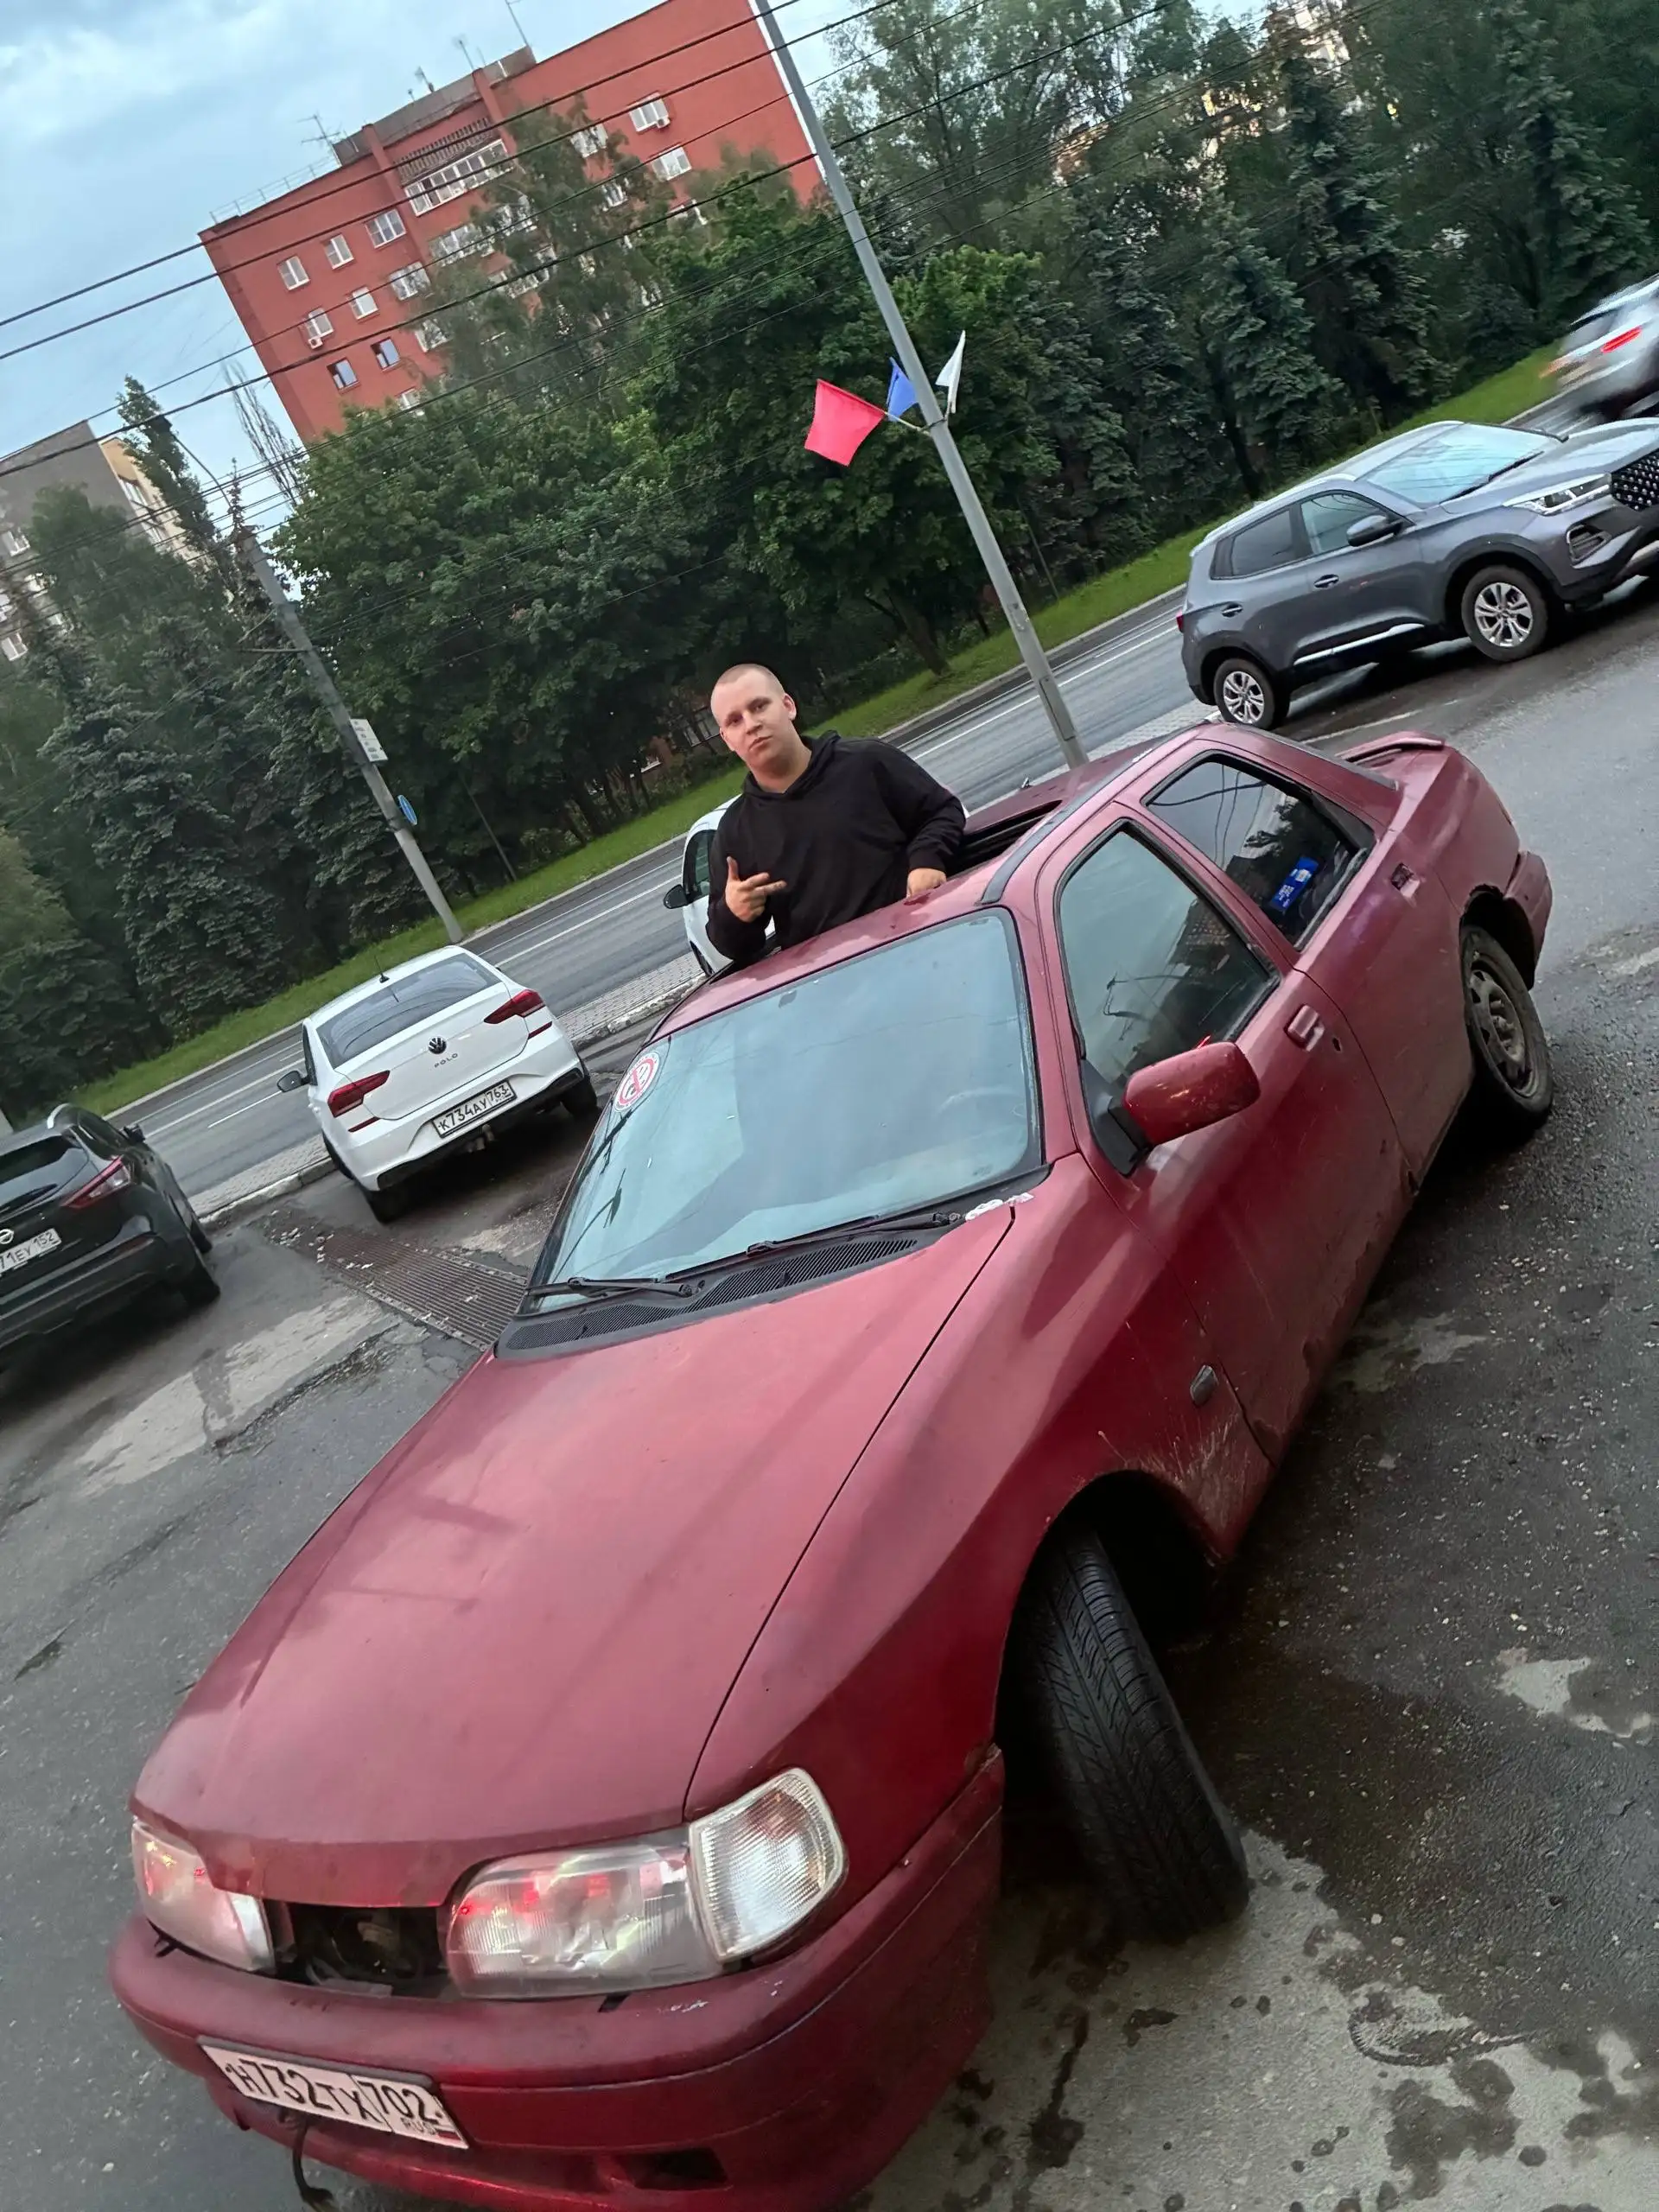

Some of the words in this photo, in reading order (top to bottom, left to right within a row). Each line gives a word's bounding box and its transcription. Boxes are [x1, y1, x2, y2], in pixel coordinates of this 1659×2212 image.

[434, 1053, 459, 1068] POLO
[486, 1084, 507, 1102] 763
[358, 2081, 440, 2123] 702
